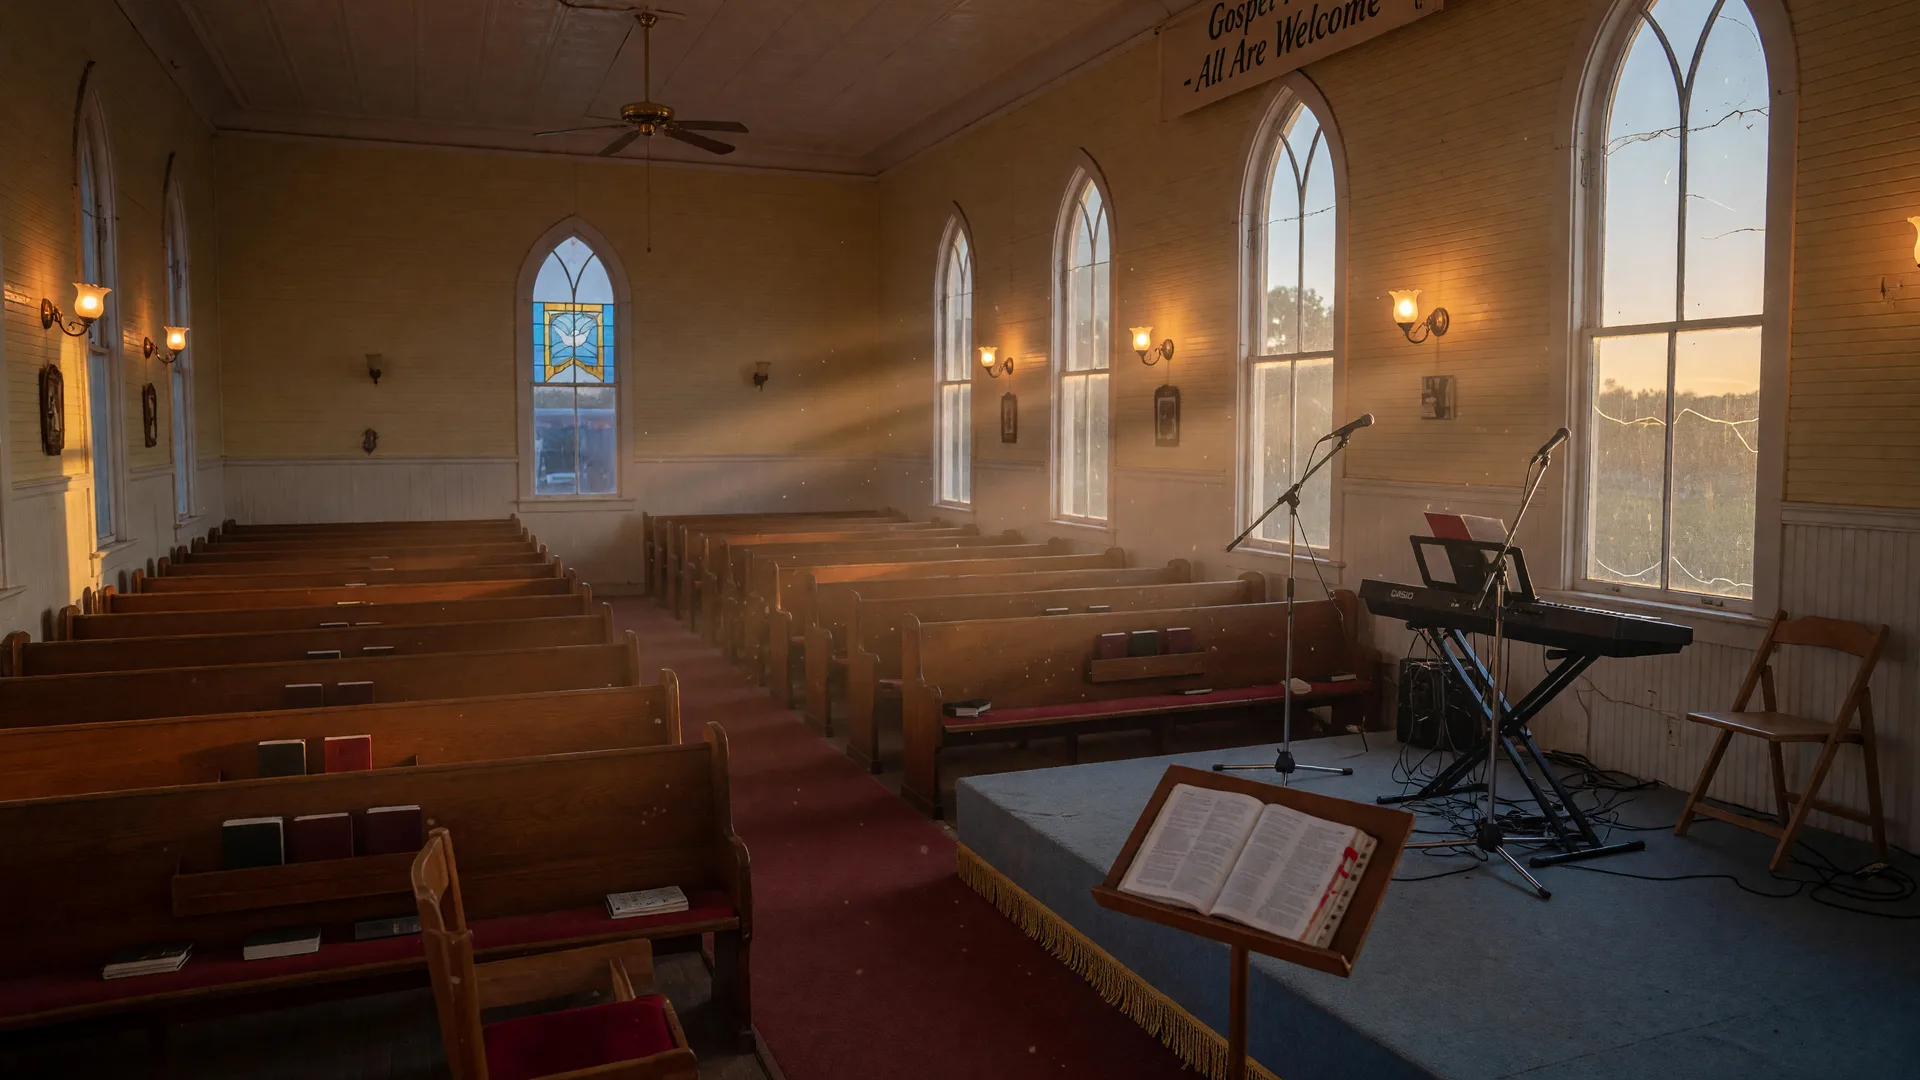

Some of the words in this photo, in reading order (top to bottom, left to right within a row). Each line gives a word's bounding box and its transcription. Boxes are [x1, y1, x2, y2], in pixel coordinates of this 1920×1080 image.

[1229, 38, 1266, 78] Are
[1276, 0, 1381, 57] Welcome
[1390, 589, 1414, 599] CASIO
